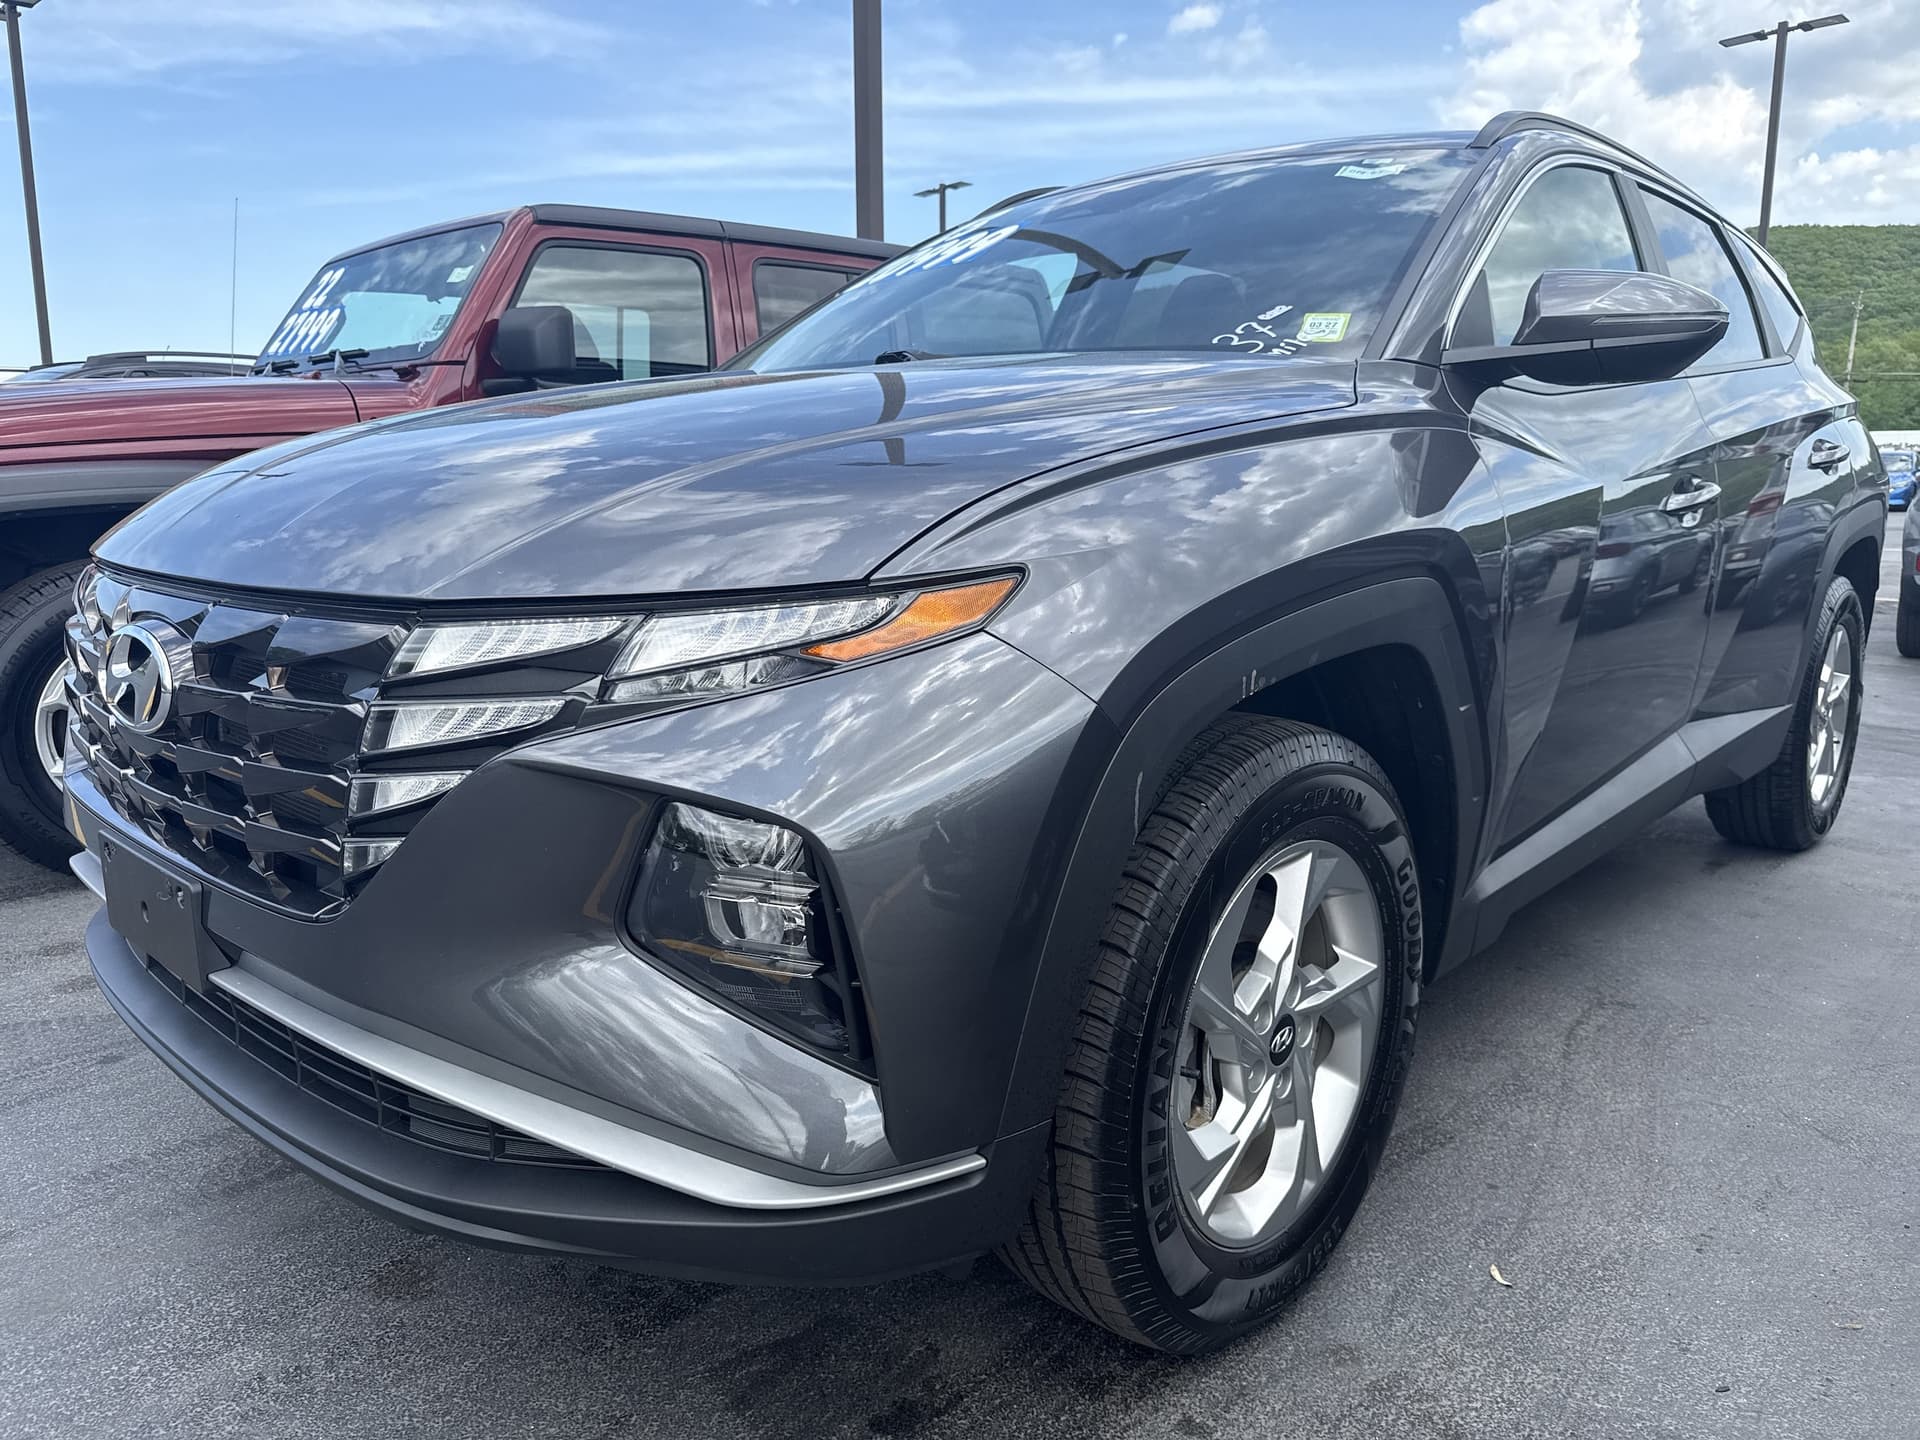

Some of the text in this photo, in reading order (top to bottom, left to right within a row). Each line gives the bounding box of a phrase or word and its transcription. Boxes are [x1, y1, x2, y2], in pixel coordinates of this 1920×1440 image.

[302, 267, 346, 311] 22
[1309, 320, 1339, 329] 03 27
[1147, 993, 1178, 1243] RELIANT
